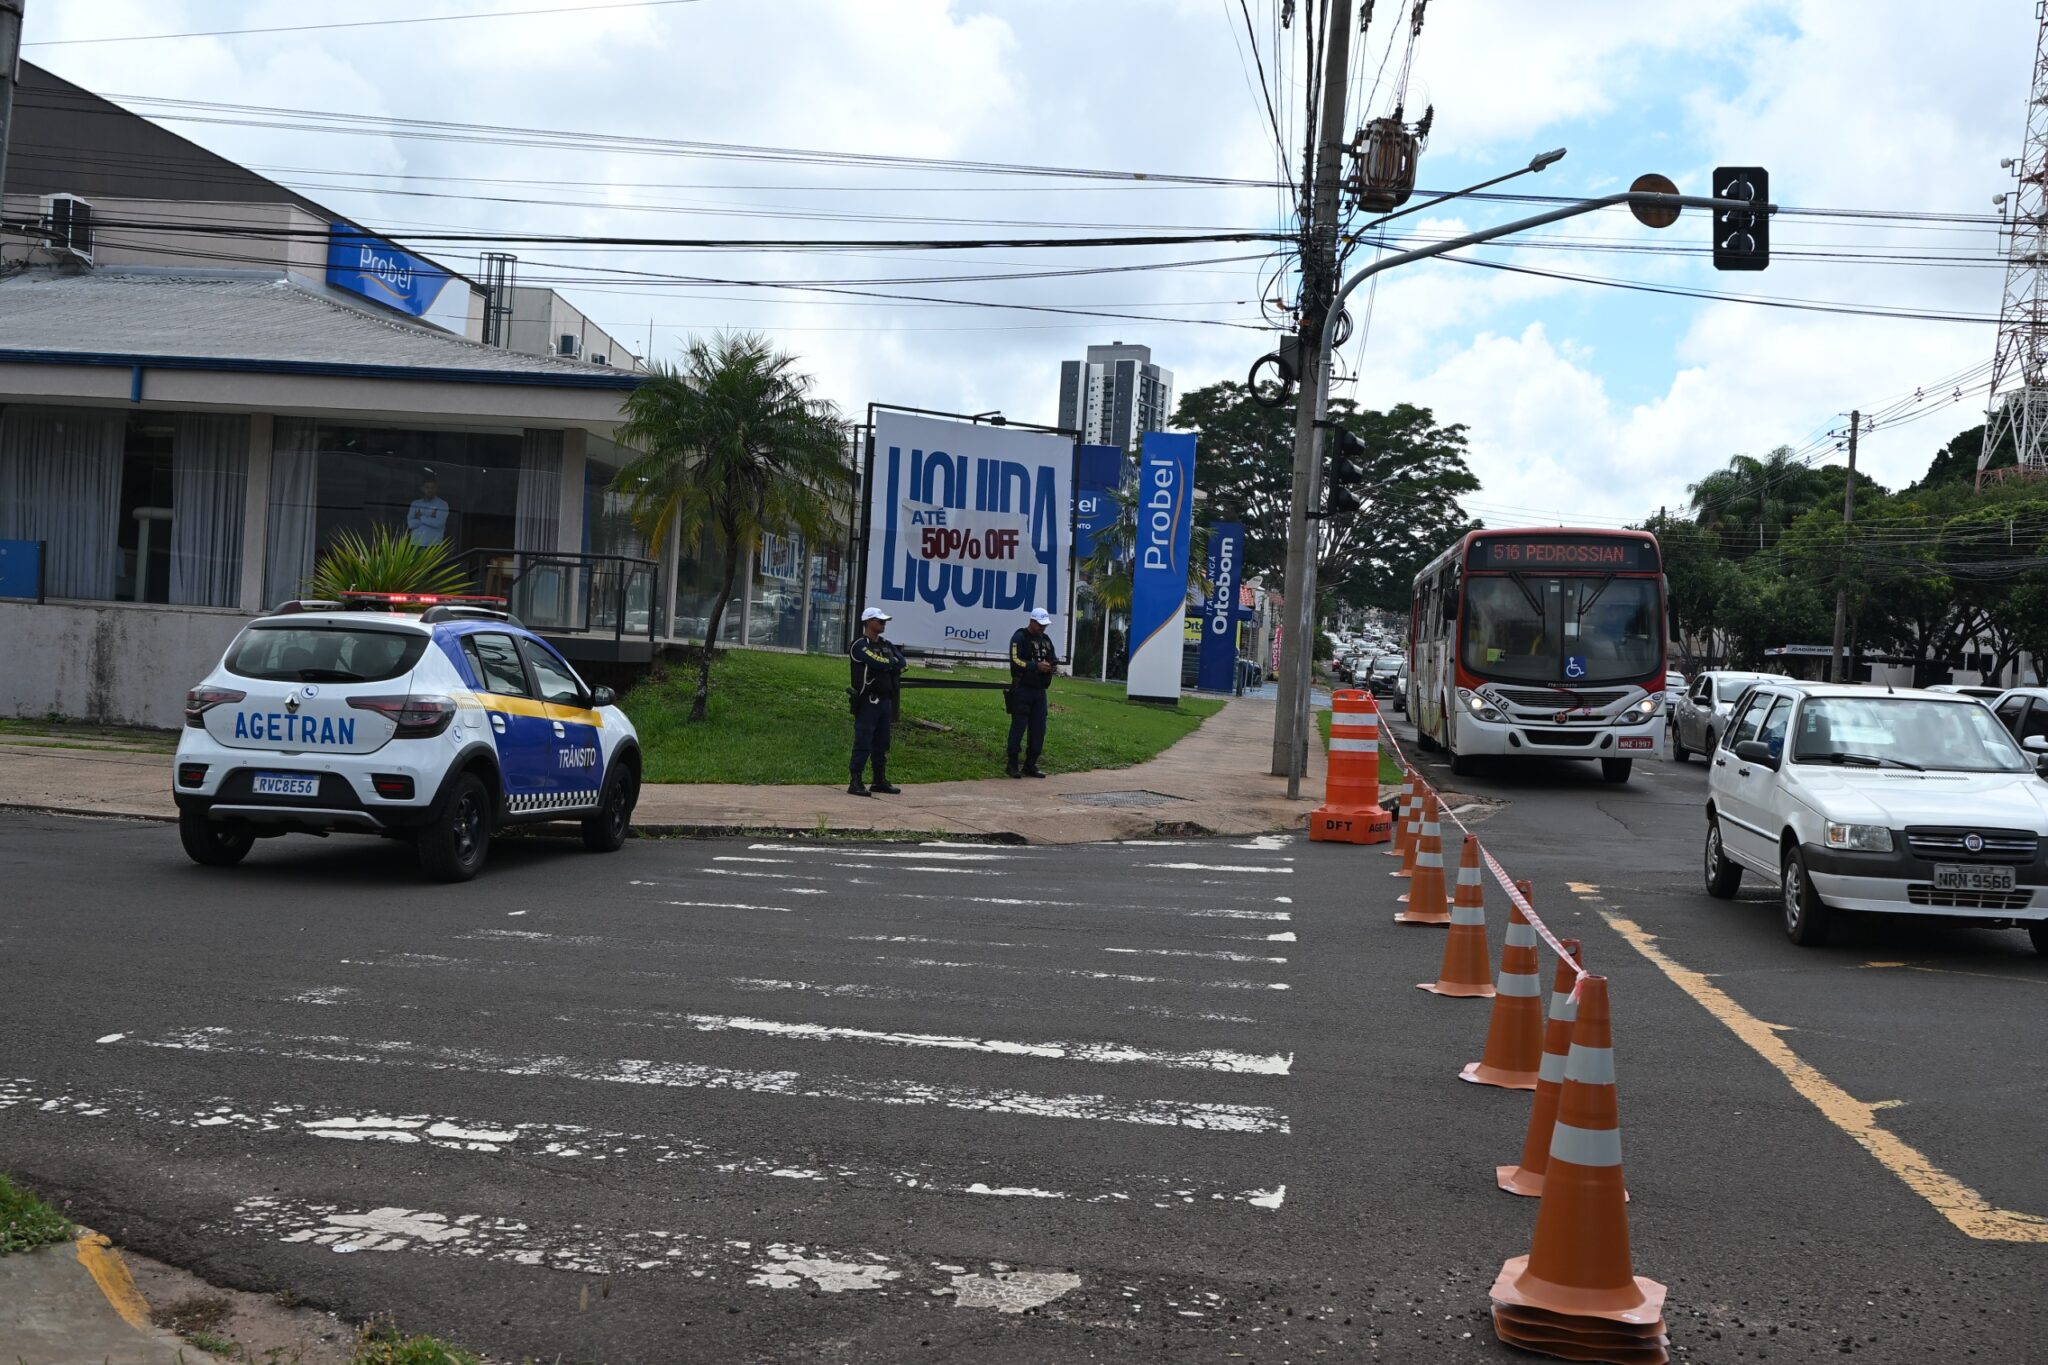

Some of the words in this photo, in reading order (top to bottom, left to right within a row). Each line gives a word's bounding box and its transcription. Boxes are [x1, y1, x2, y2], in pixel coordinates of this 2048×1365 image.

[359, 243, 412, 291] Probel
[911, 507, 947, 526] ATÉ
[1144, 459, 1174, 570] Probel
[881, 446, 1057, 615] LIQUIDA
[921, 527, 981, 560] 50%
[985, 528, 1020, 560] OFF
[1493, 543, 1520, 560] 516
[1526, 544, 1625, 562] PEDROSSIAN
[1212, 537, 1234, 635] Ortobom
[944, 625, 990, 641] Probel
[1482, 688, 1510, 710] 1278
[235, 711, 355, 745] AGETRAN
[559, 744, 596, 769] TRÂNSITO
[258, 778, 312, 794] RWC8E56
[1326, 820, 1353, 831] DFT
